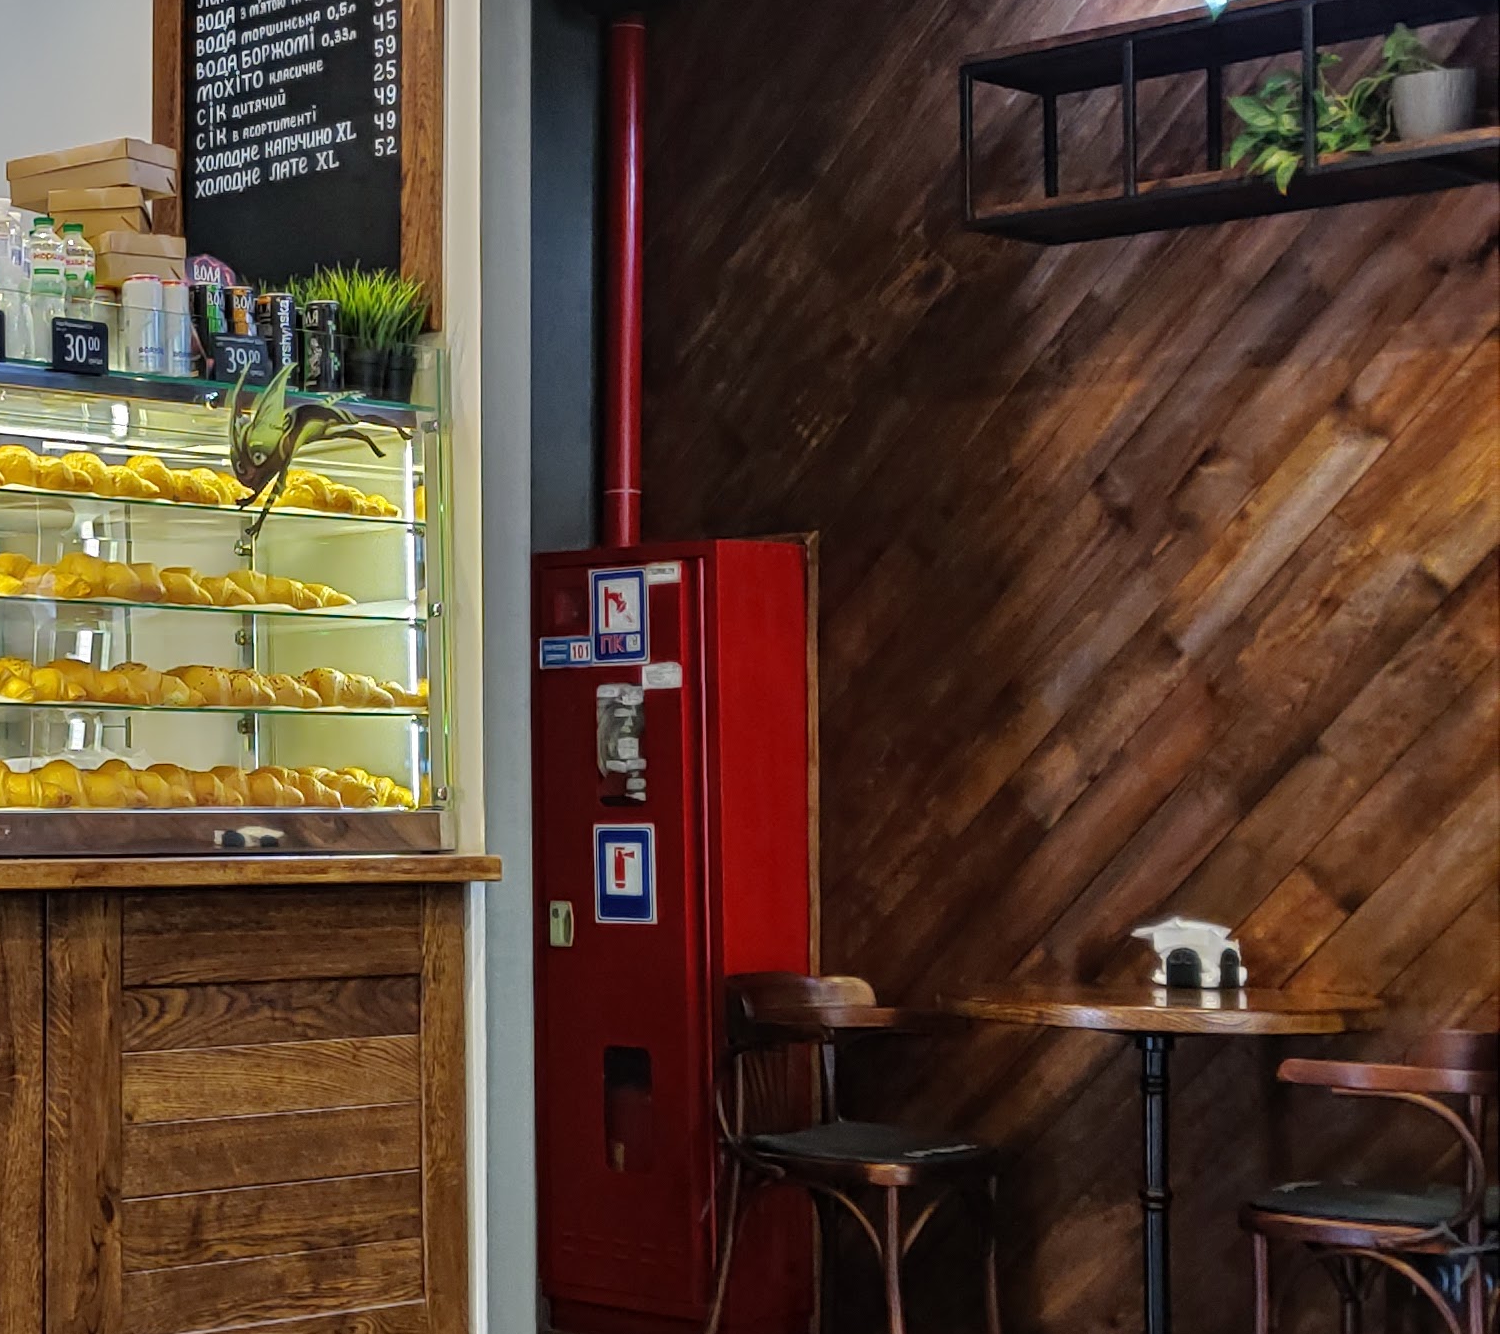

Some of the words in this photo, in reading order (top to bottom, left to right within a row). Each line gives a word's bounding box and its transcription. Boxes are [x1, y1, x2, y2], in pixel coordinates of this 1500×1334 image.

[373, 9, 398, 33] 45
[374, 34, 397, 59] 59
[373, 59, 398, 83] 25
[373, 83, 398, 106] 49
[373, 109, 398, 132] 49
[374, 136, 398, 158] 52
[193, 264, 220, 283] ВОЛЯ
[64, 333, 88, 364] 30
[87, 336, 100, 352] 00
[279, 298, 292, 377] orshynska
[225, 346, 247, 374] 39
[572, 644, 589, 659] 101
[600, 634, 626, 655] ПК
